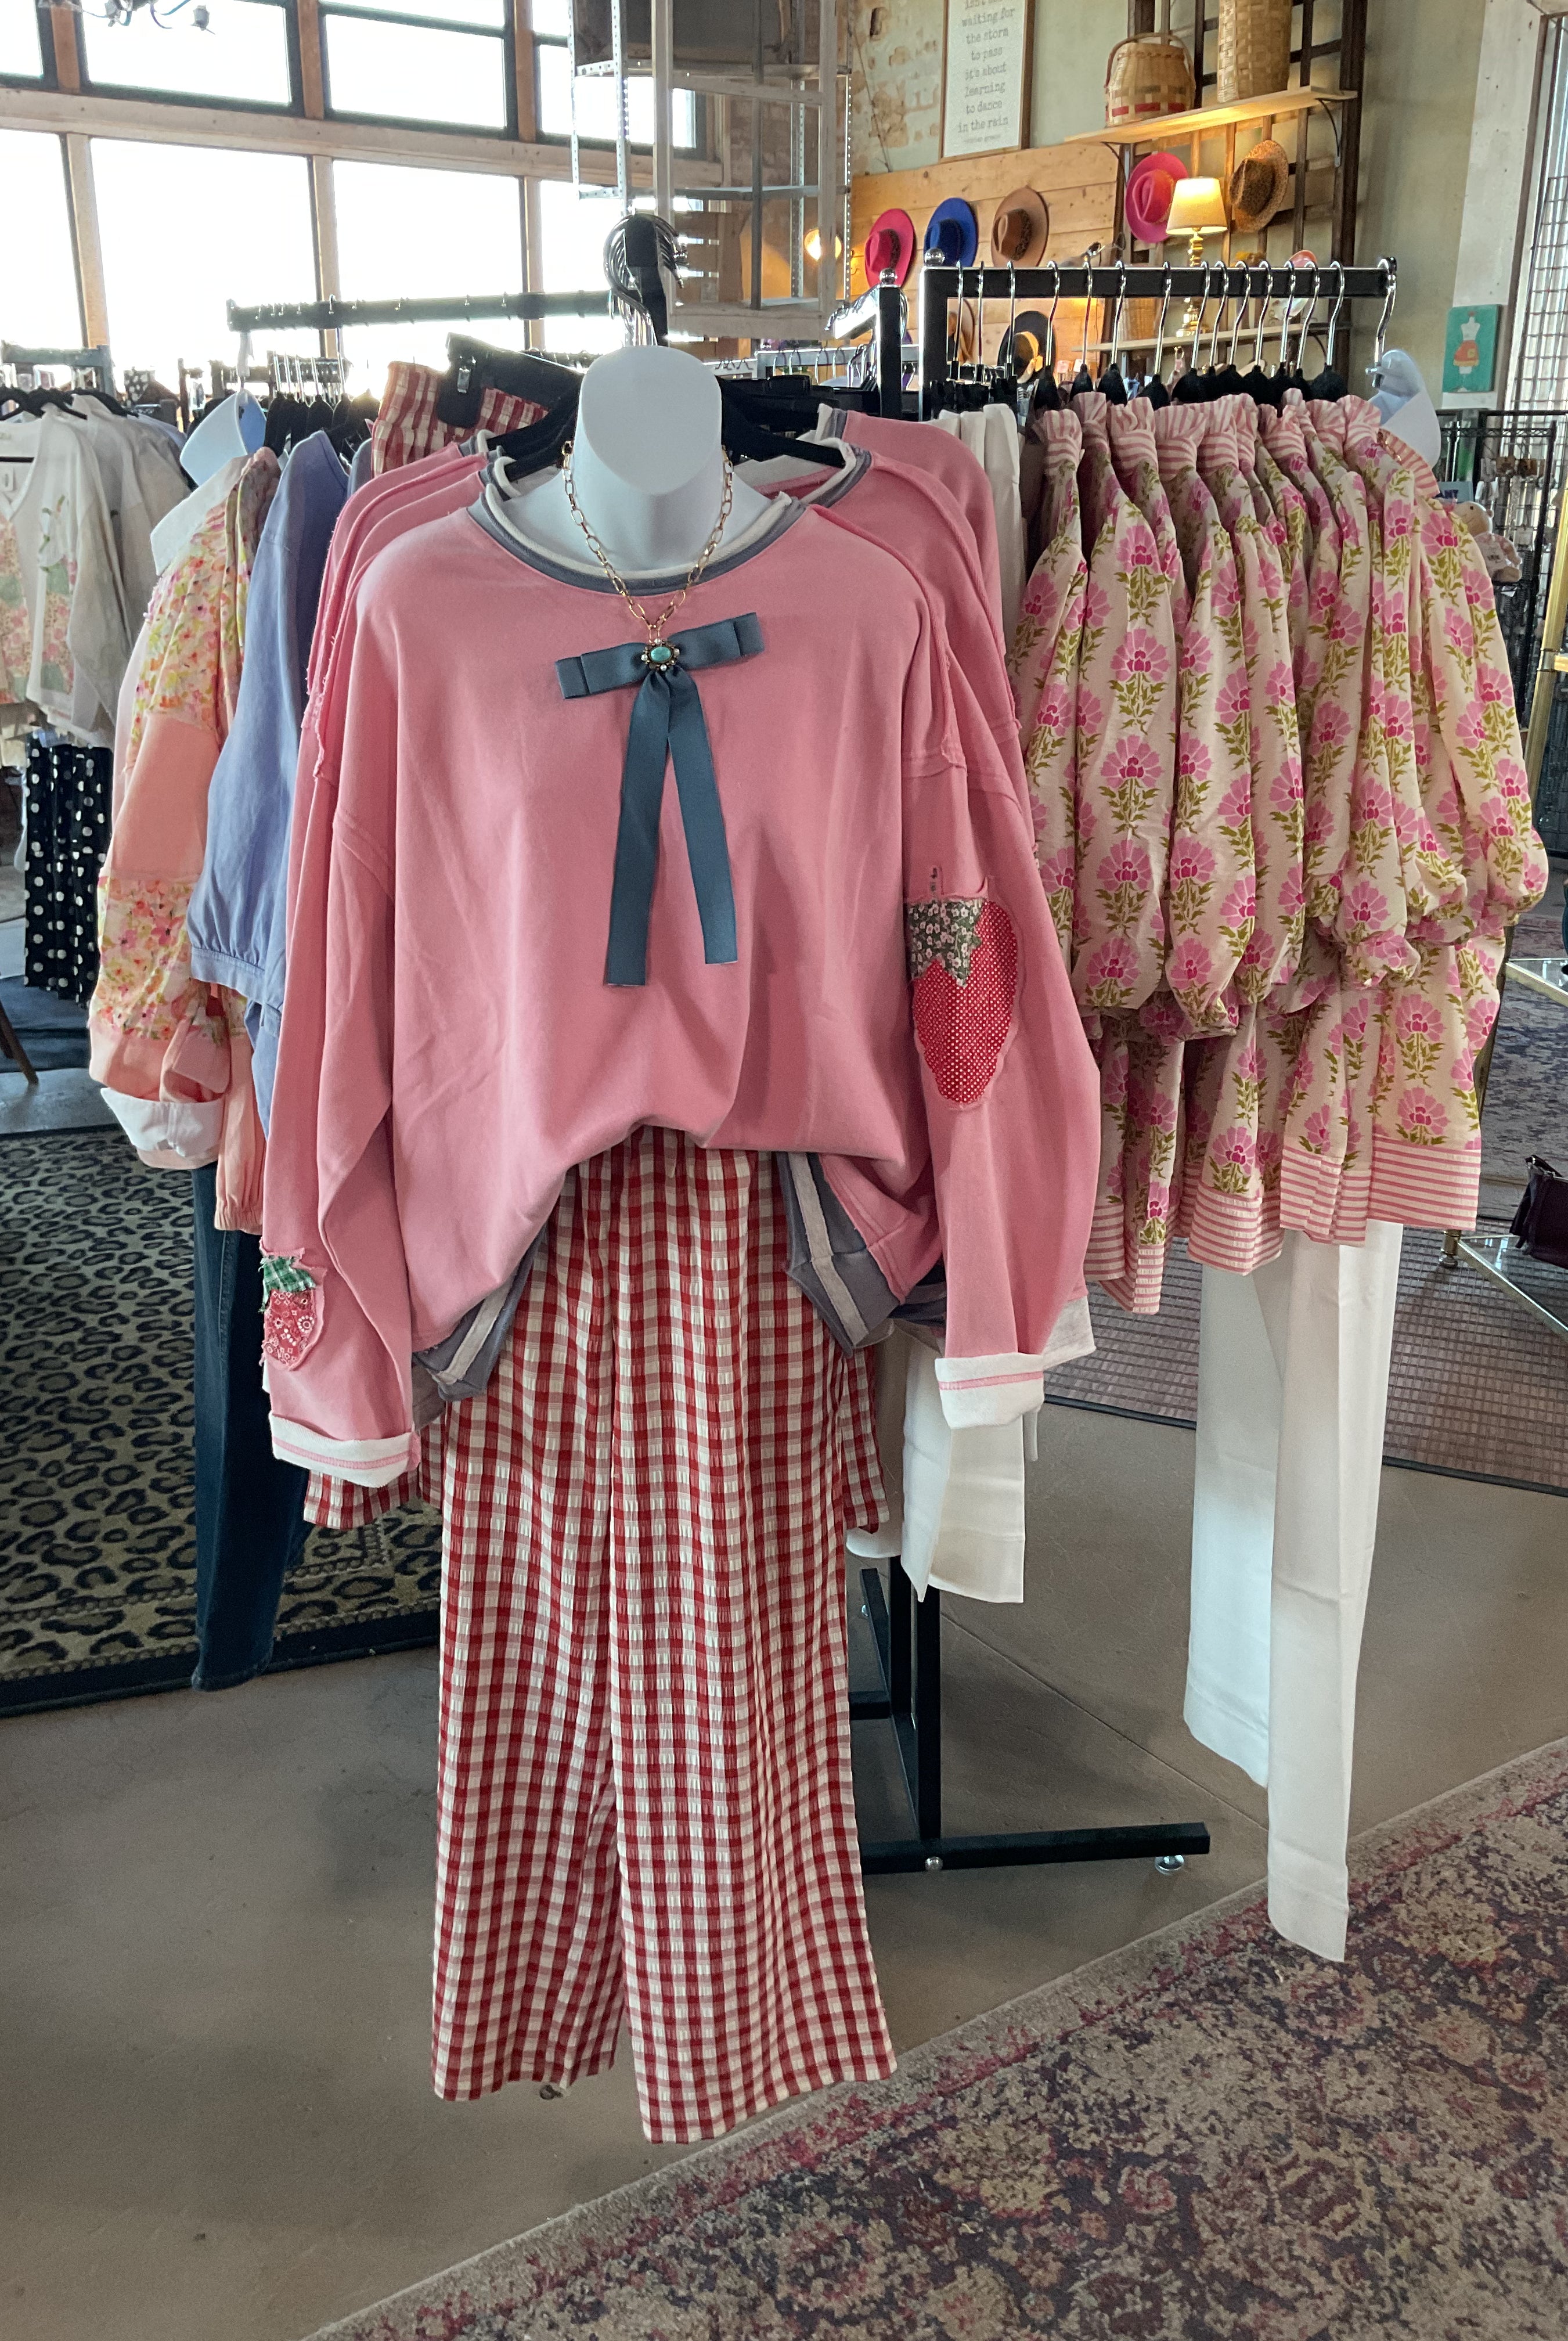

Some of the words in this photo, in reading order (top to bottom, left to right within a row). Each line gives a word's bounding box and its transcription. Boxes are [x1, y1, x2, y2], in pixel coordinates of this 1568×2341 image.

[961, 12, 999, 28] waiting
[1000, 7, 1015, 19] for
[965, 33, 981, 44] the
[983, 27, 1009, 41] storm
[971, 50, 981, 61] to
[982, 46, 1003, 63] pass
[982, 60, 1007, 76] about
[964, 81, 1005, 98] learning
[966, 105, 975, 114] to
[977, 100, 1003, 112] dance
[957, 121, 968, 133] in
[971, 118, 986, 131] the
[988, 115, 1008, 128] rain
